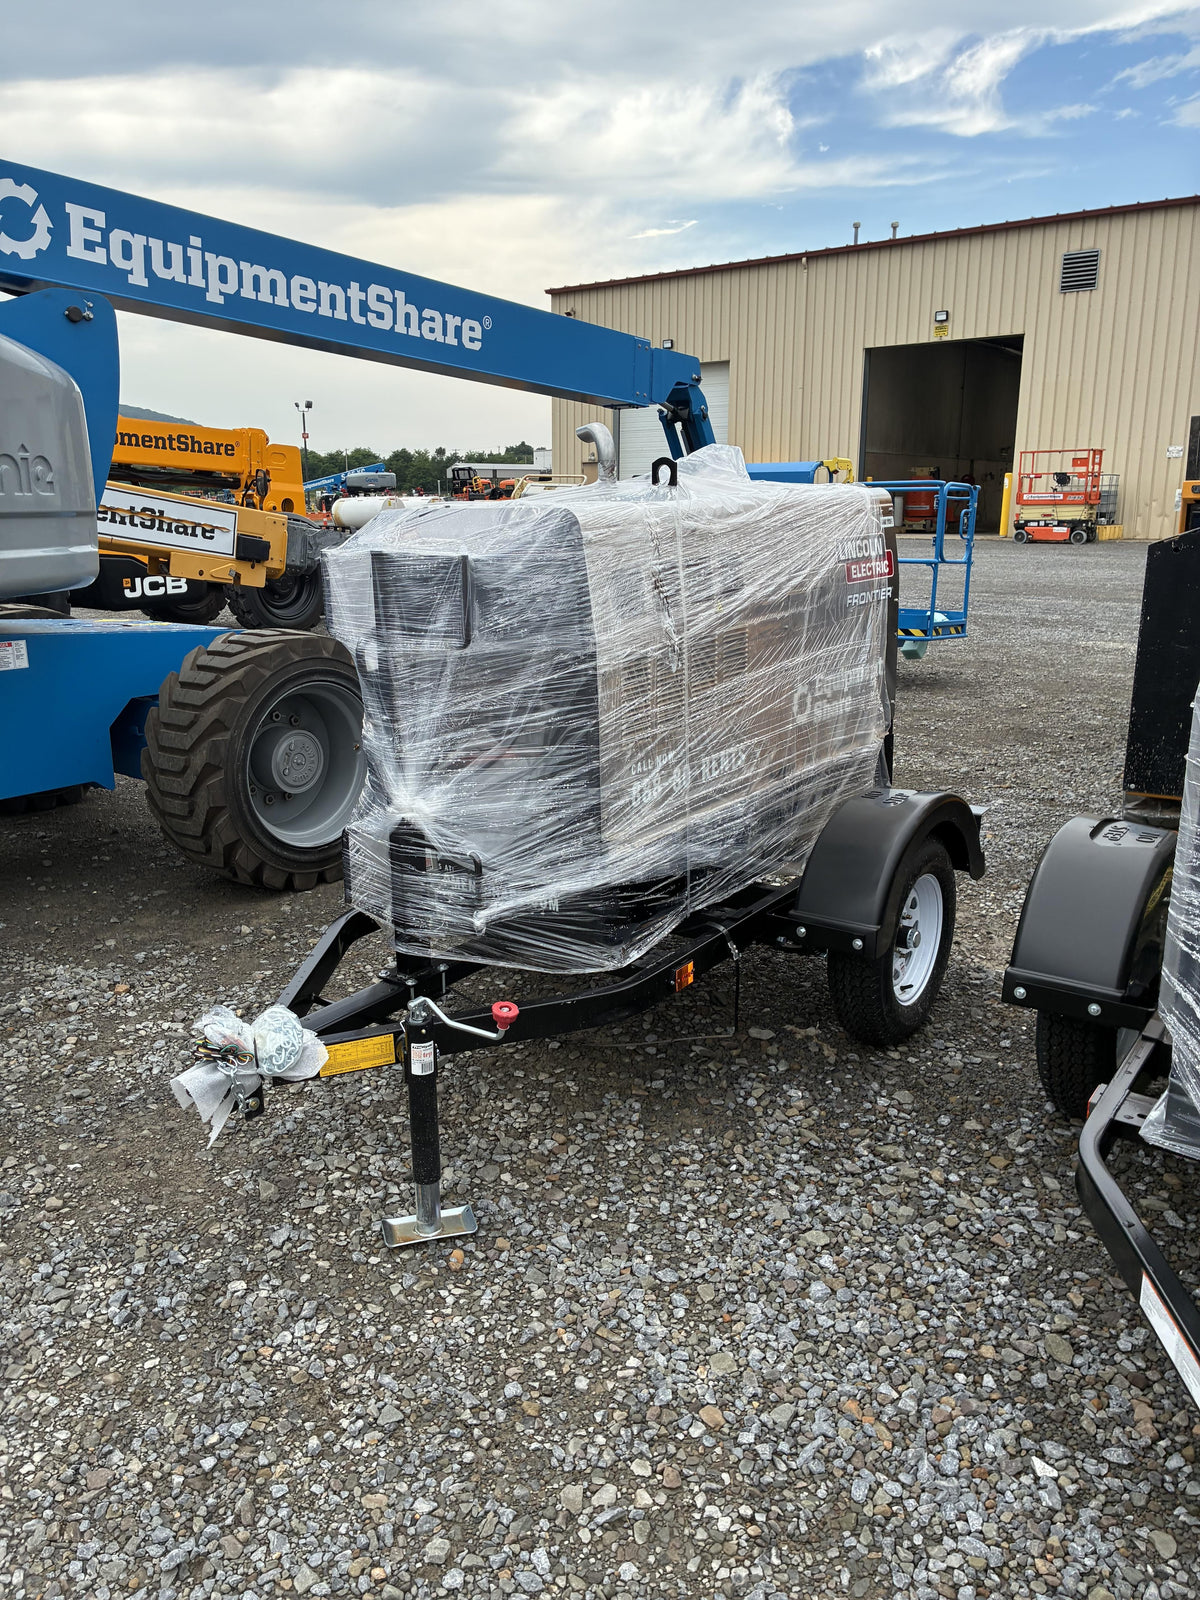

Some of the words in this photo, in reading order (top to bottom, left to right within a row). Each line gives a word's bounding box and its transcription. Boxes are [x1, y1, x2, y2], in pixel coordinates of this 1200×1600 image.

[840, 537, 883, 560] LINCOLN
[851, 561, 889, 579] ELECTRIC
[123, 576, 188, 598] JCB
[846, 587, 892, 607] FRONTIER
[631, 759, 654, 776] CALL
